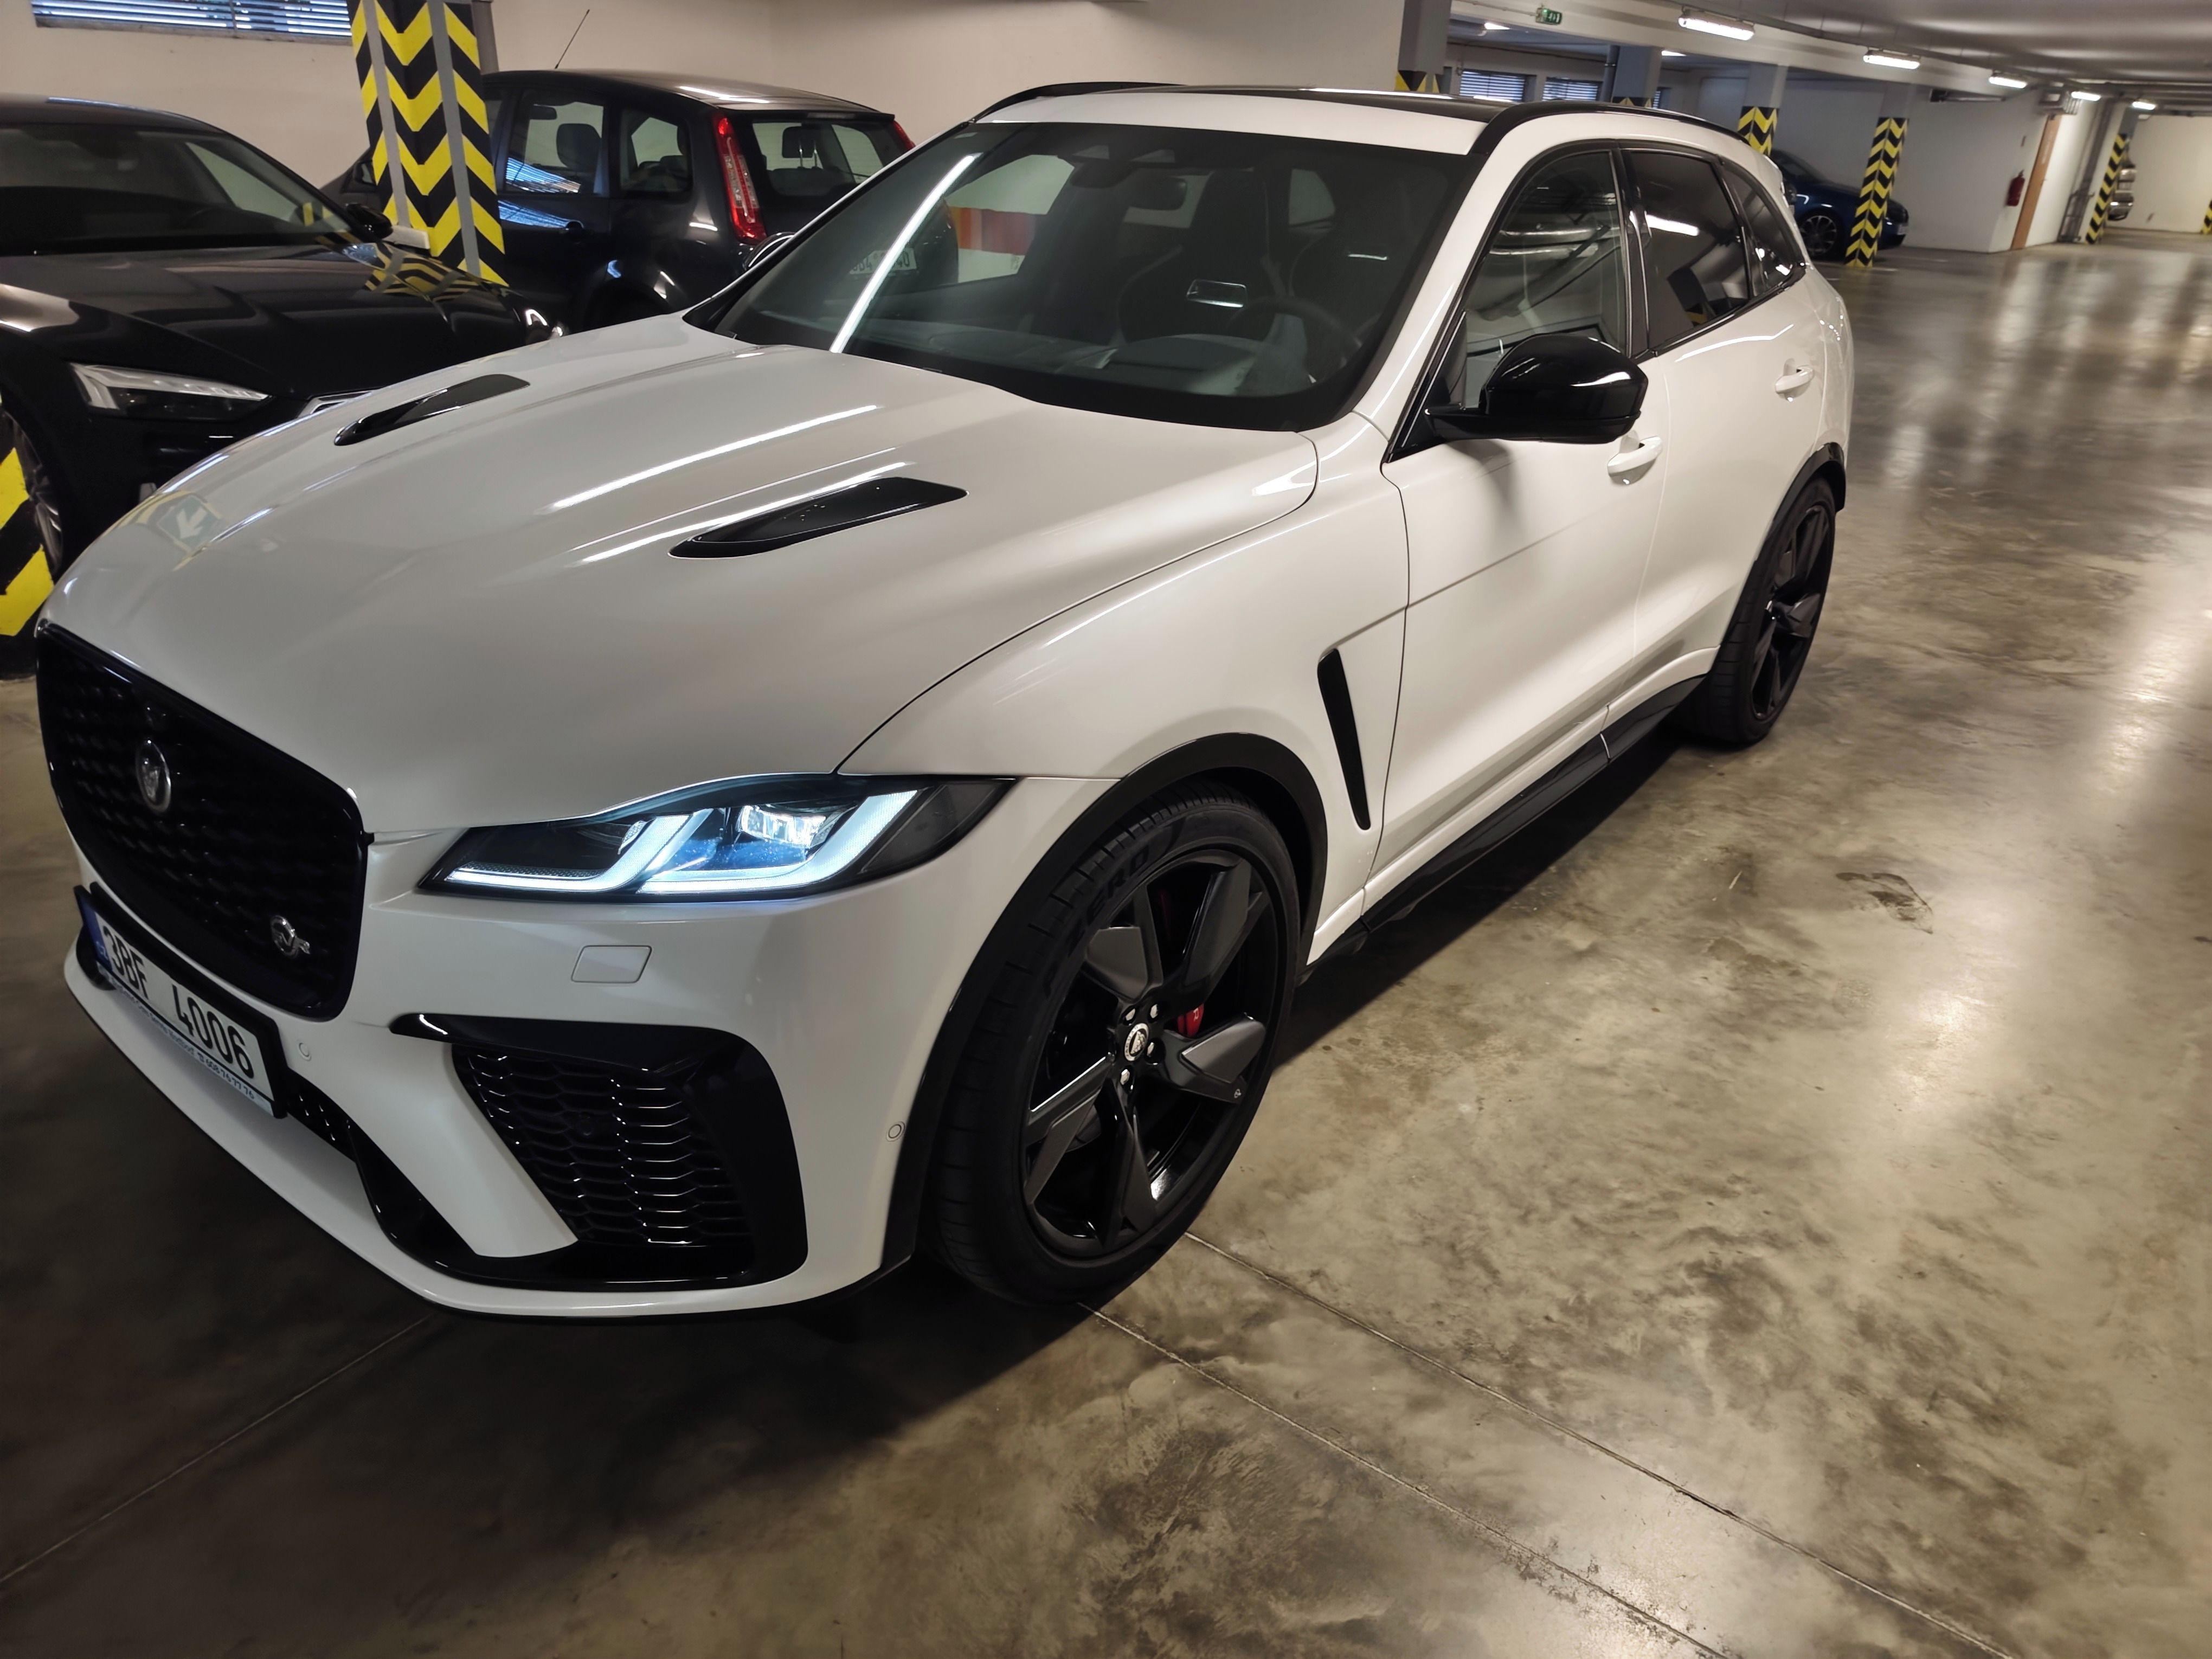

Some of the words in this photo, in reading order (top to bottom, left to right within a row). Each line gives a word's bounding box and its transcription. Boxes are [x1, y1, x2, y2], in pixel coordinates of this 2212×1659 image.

[102, 925, 149, 1000] 3BF
[172, 983, 254, 1079] 4006
[221, 1069, 232, 1083] 76
[232, 1078, 242, 1090] 77
[243, 1087, 255, 1100] 76
